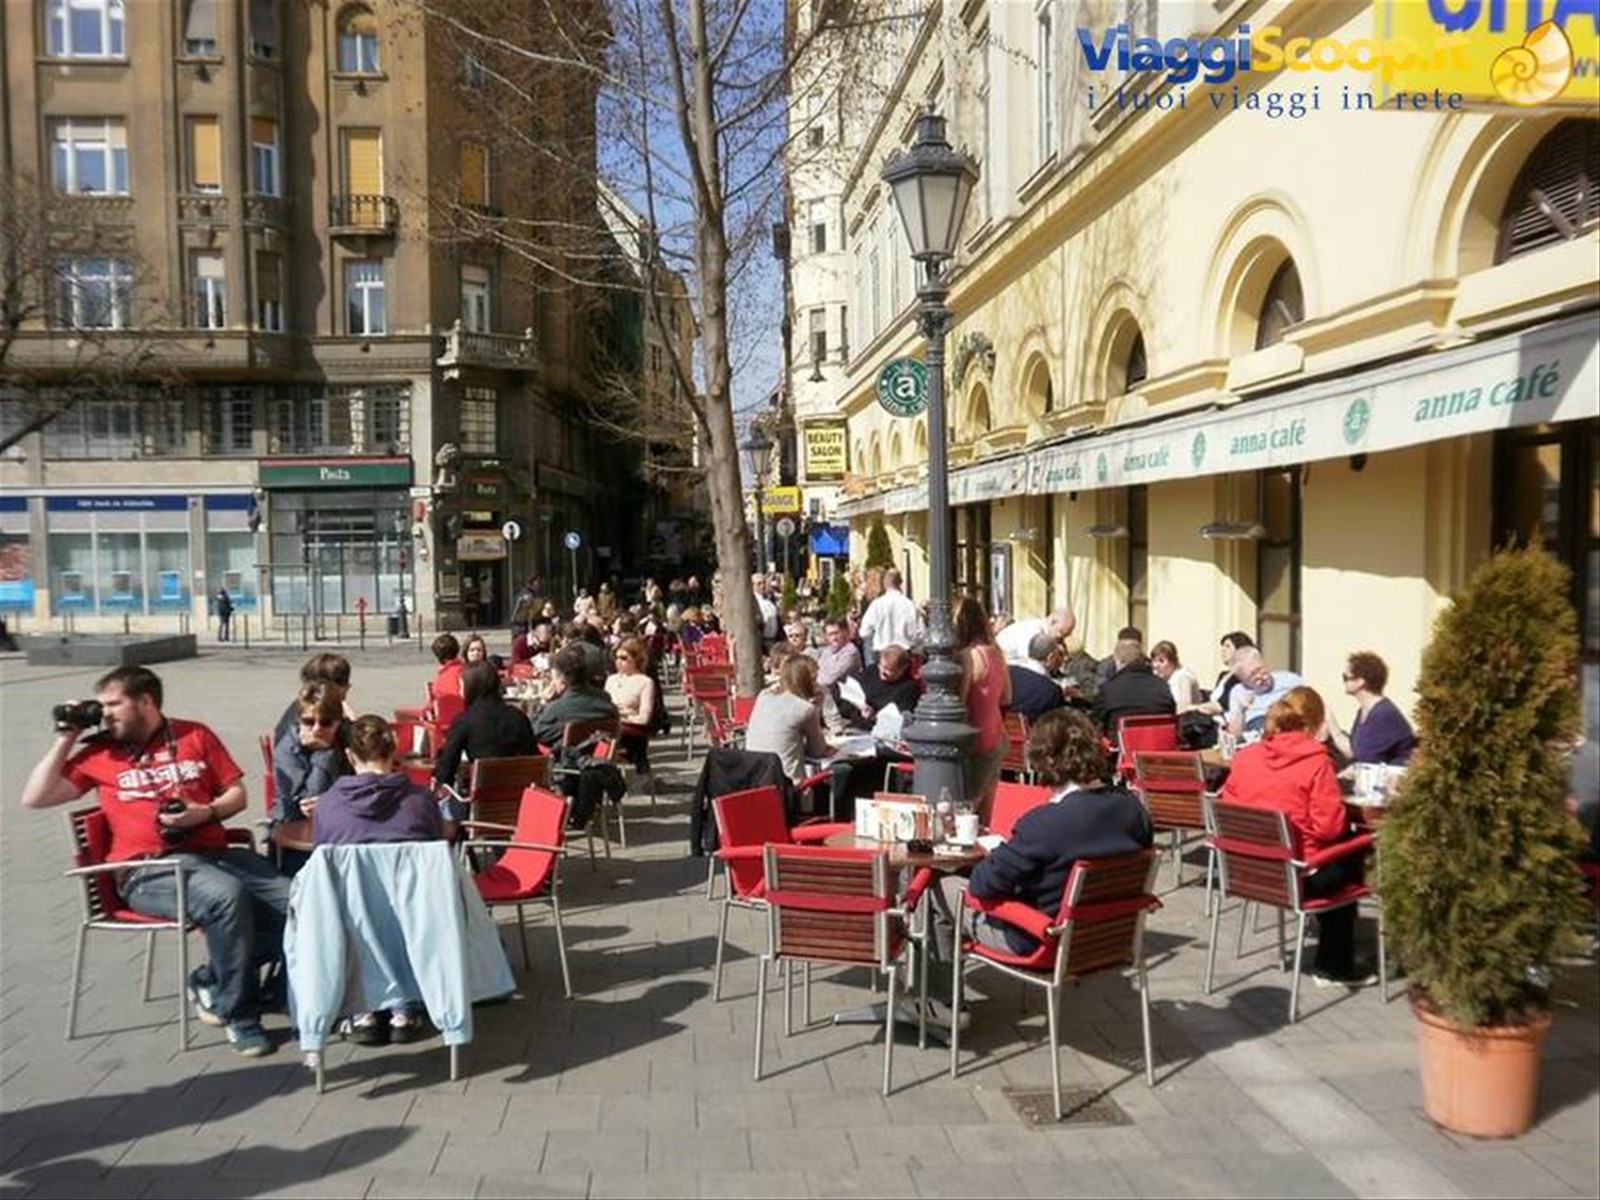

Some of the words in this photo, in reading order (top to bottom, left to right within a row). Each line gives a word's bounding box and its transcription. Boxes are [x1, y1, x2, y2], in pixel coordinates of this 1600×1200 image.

[1415, 385, 1483, 422] anna
[1489, 360, 1561, 407] café
[808, 433, 842, 444] BEAUTY
[1230, 430, 1267, 455] anna
[1270, 418, 1306, 449] café
[811, 446, 841, 457] SALON
